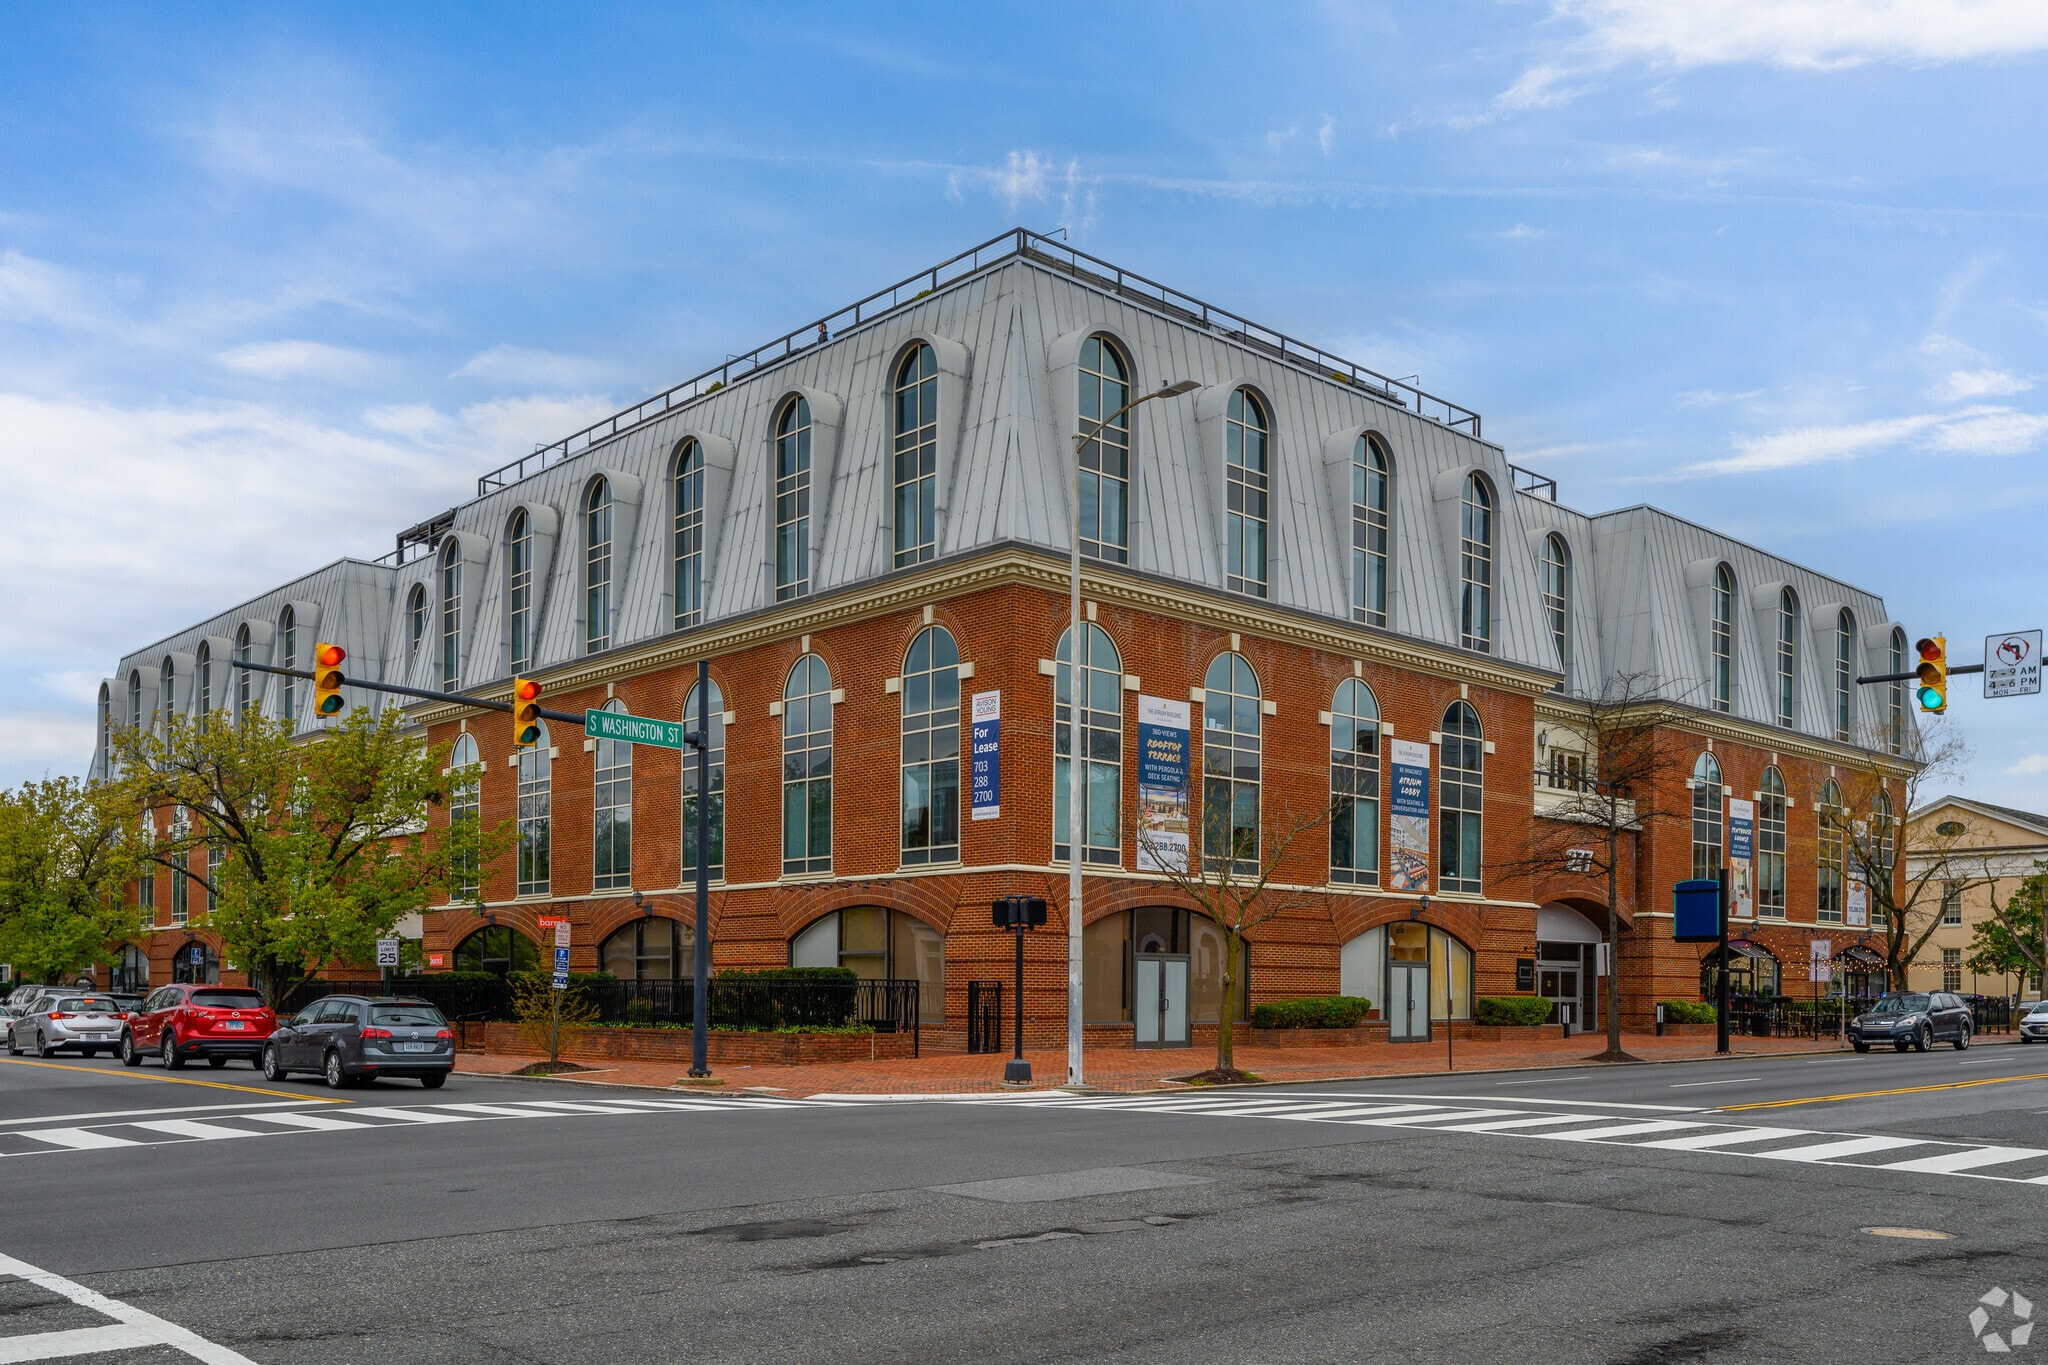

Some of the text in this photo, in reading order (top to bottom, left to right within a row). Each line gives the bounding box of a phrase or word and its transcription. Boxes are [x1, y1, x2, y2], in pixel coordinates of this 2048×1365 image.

[1989, 670, 1997, 679] 7
[2009, 668, 2016, 676] 9
[2020, 666, 2037, 675] AM
[1988, 681, 1996, 689] 4
[2009, 679, 2016, 687] 6
[2020, 677, 2037, 686] PM
[976, 698, 997, 706] AVISON
[976, 704, 997, 713] YOUNG
[590, 715, 679, 743] S WASHINGTON ST
[974, 727, 989, 739] For
[974, 742, 998, 754] Lease
[1147, 738, 1183, 752] ROOFTOP
[1148, 750, 1181, 763] TERRACE
[974, 760, 989, 773] 703
[1145, 763, 1158, 771] WITH
[1158, 765, 1180, 774] PERGOLA
[974, 775, 989, 788] 288
[1148, 772, 1181, 783] DECK SEATING
[1399, 777, 1422, 786] ATRIUM
[974, 789, 993, 802] 2700
[1401, 787, 1420, 796] LOBBY
[1141, 841, 1186, 852] 288.2700
[379, 953, 396, 963] 25
